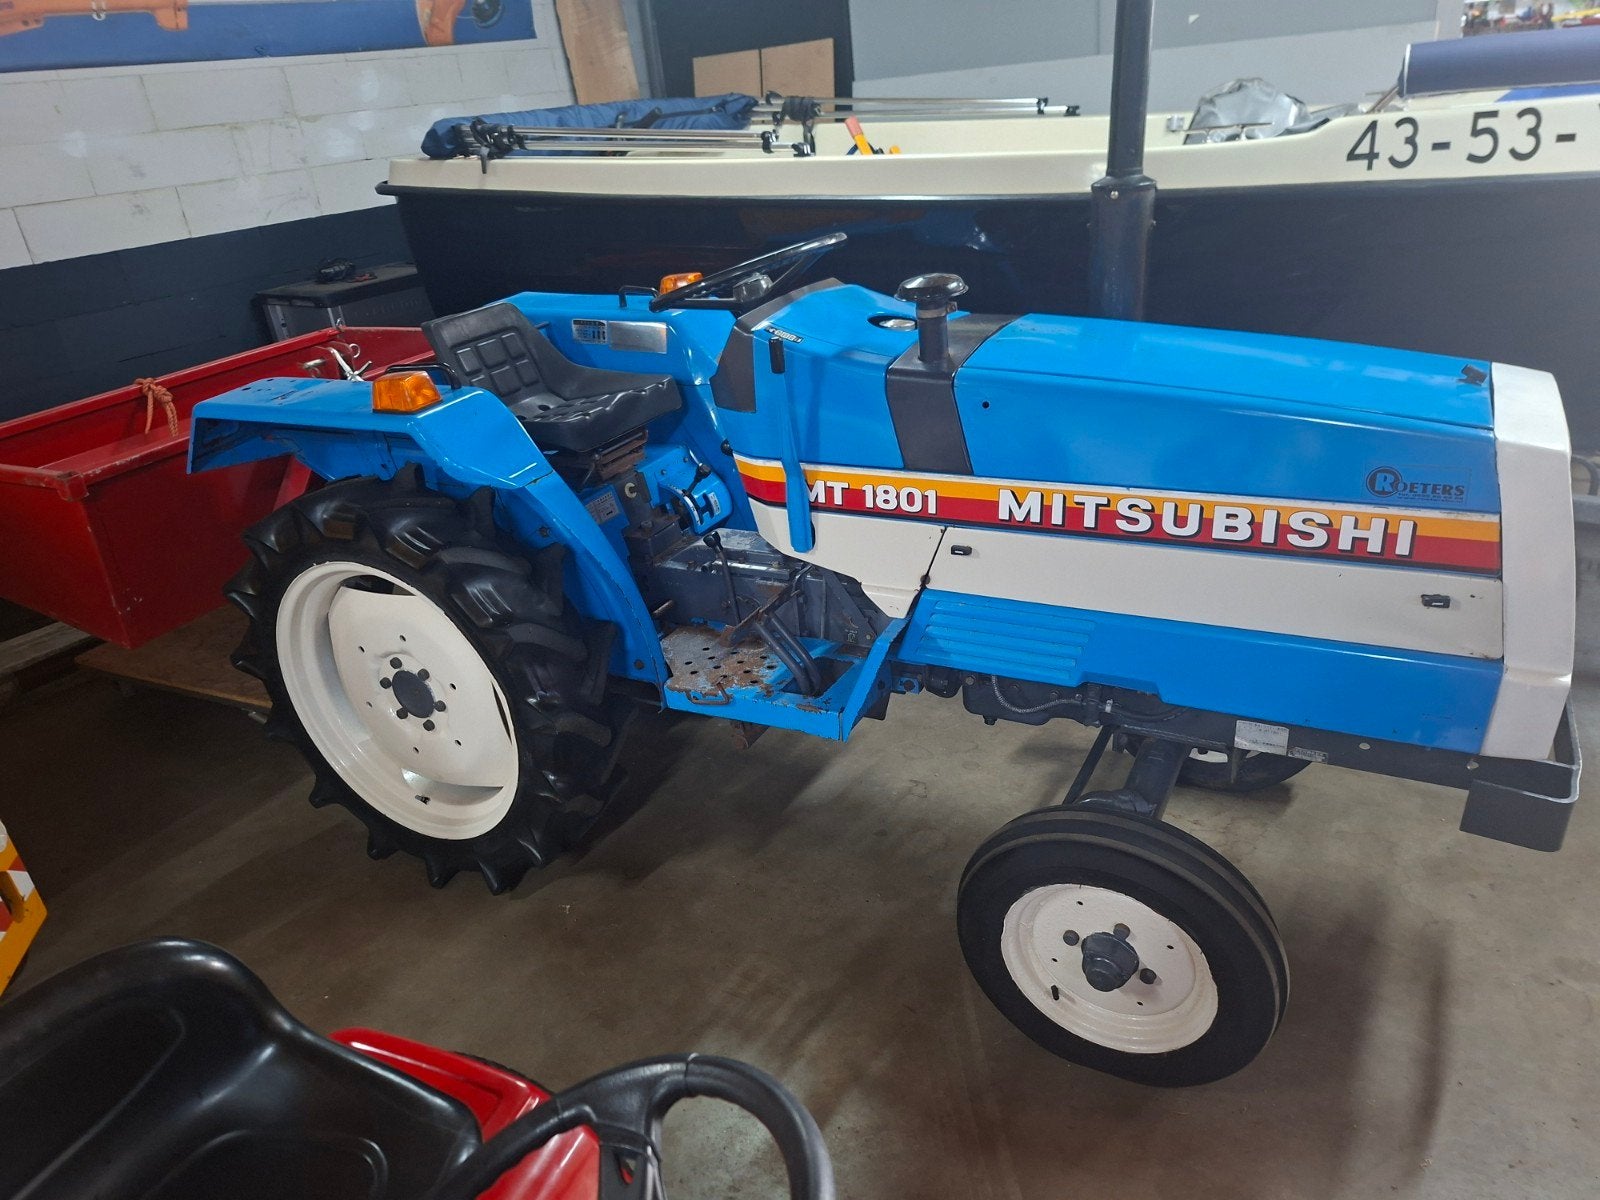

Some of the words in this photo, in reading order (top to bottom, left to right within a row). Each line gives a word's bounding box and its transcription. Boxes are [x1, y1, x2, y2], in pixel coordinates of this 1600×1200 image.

[1346, 107, 1600, 171] 43-53-
[861, 484, 937, 515] 1801
[1367, 467, 1465, 497] ROETERS
[998, 489, 1417, 557] MITSUBISHI
